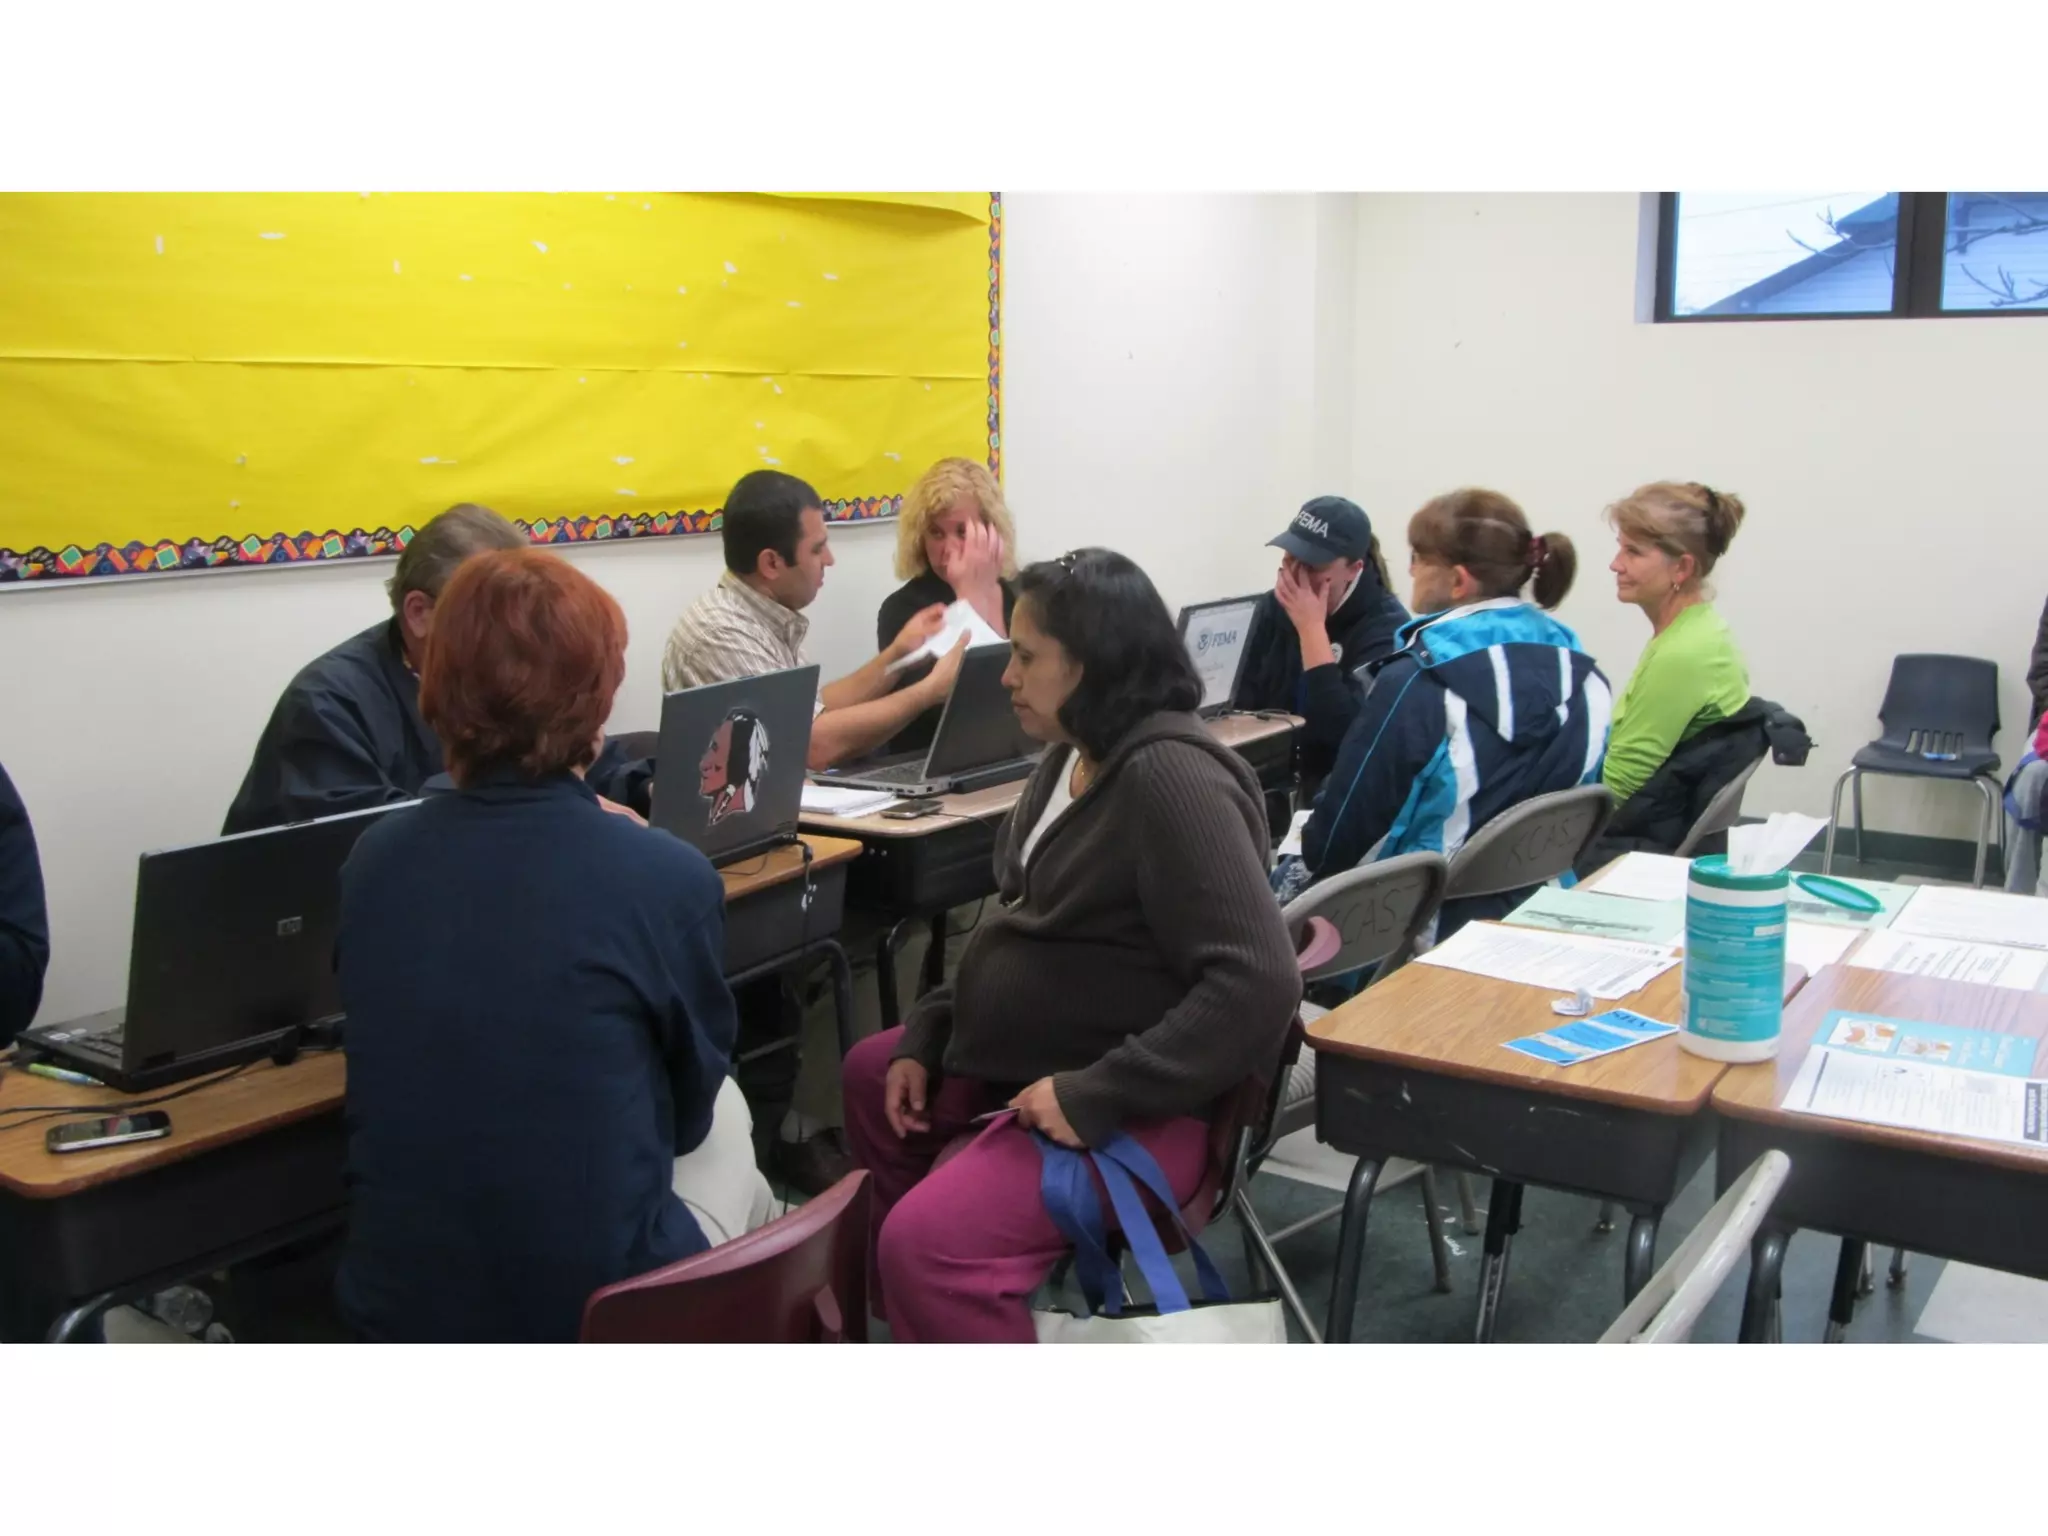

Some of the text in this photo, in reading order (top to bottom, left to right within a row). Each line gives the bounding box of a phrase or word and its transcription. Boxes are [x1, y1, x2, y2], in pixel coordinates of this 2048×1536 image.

[1294, 510, 1329, 538] FEMA
[1210, 630, 1237, 648] FEMA
[1330, 888, 1401, 945] CAS
